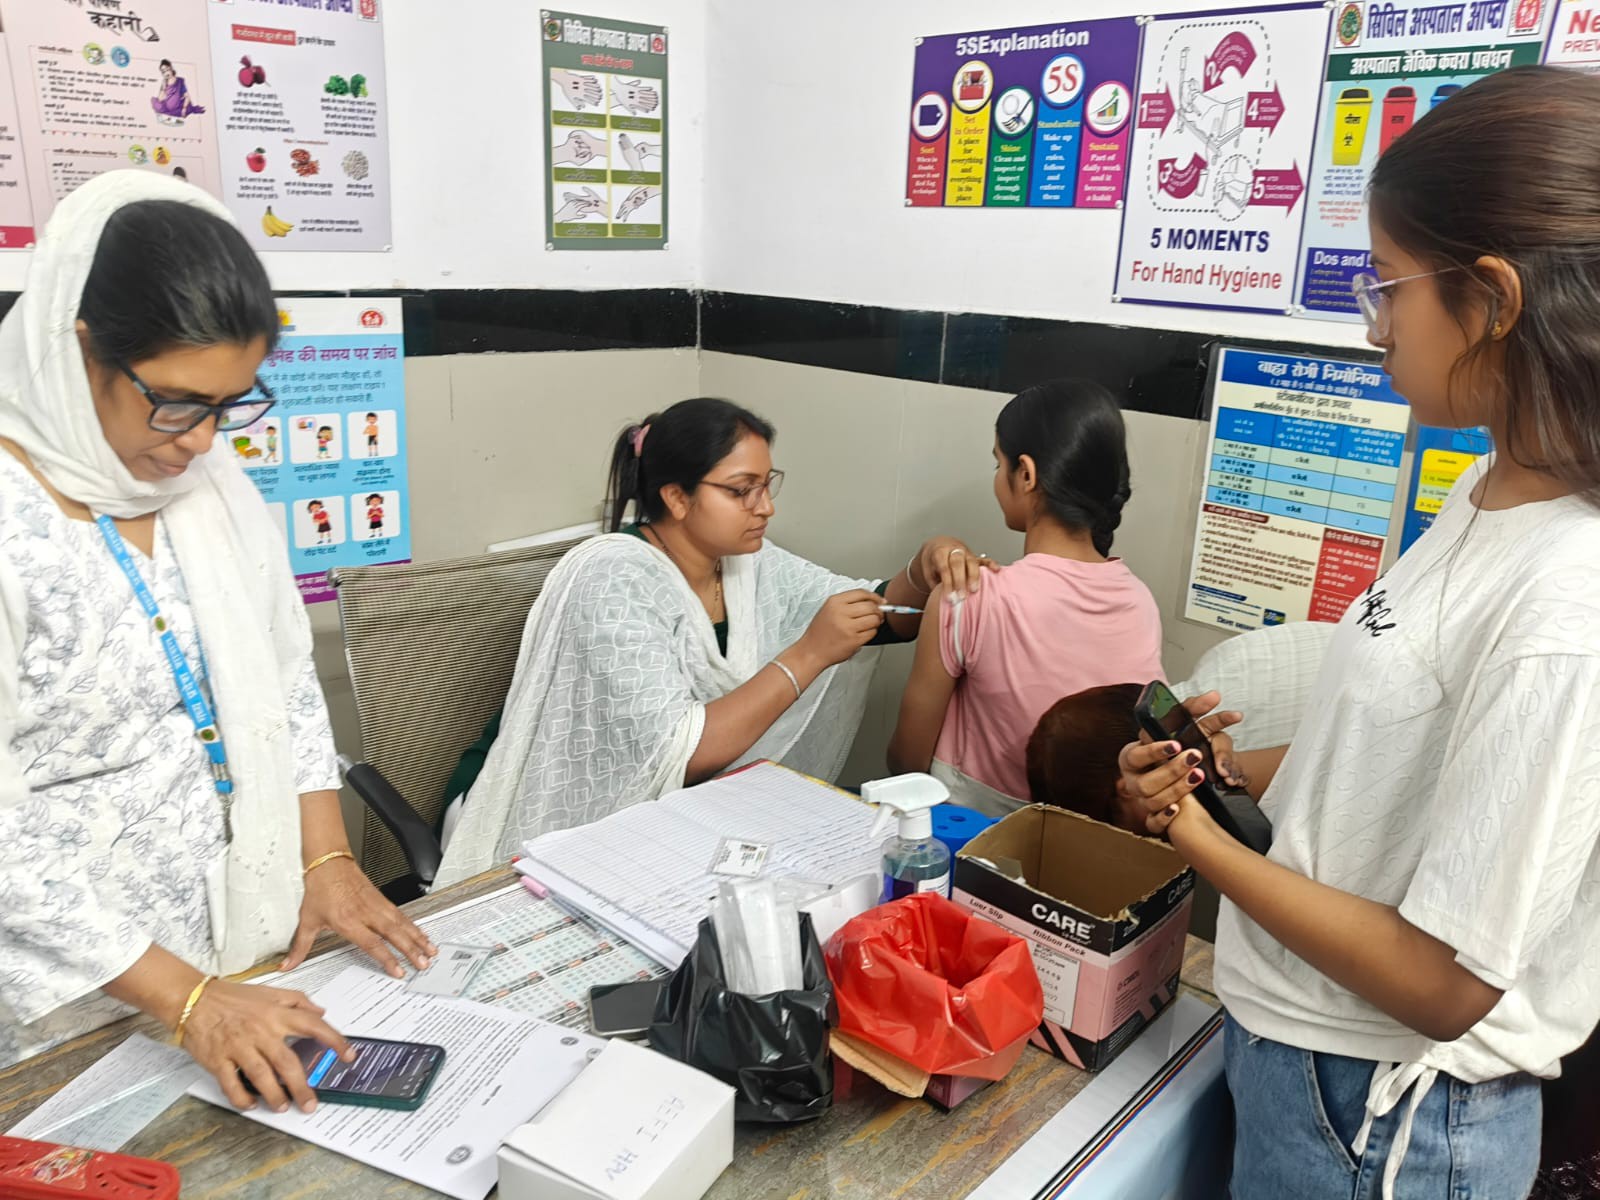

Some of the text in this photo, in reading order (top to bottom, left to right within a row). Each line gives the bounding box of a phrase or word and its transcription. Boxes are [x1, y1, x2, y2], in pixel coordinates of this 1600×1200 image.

[87, 11, 143, 37] कहानी
[563, 18, 592, 45] सिविल
[1367, 0, 1508, 39] सिविल अस्पताल आष्टा
[955, 28, 1090, 57] 5SExplanation
[1206, 61, 1221, 85] 2
[1350, 55, 1401, 75] अस्पताल
[1401, 49, 1438, 73] जैविक
[1047, 63, 1079, 95] 5S
[1140, 100, 1149, 122] 1
[1248, 98, 1259, 121] 4
[1160, 163, 1173, 183] 3
[1253, 176, 1266, 199] 5
[1150, 227, 1270, 253] 5 MOMENTS
[1313, 250, 1366, 267] Dos and
[1131, 261, 1159, 282] For
[1161, 262, 1206, 285] Hand
[1208, 265, 1282, 293] Hygiene
[298, 345, 316, 362] की
[320, 348, 351, 362] समय
[354, 347, 369, 361] पर
[1322, 363, 1382, 387] निमोनिया
[1031, 903, 1092, 940] CARE
[1033, 929, 1086, 956] Ribbon Pack
